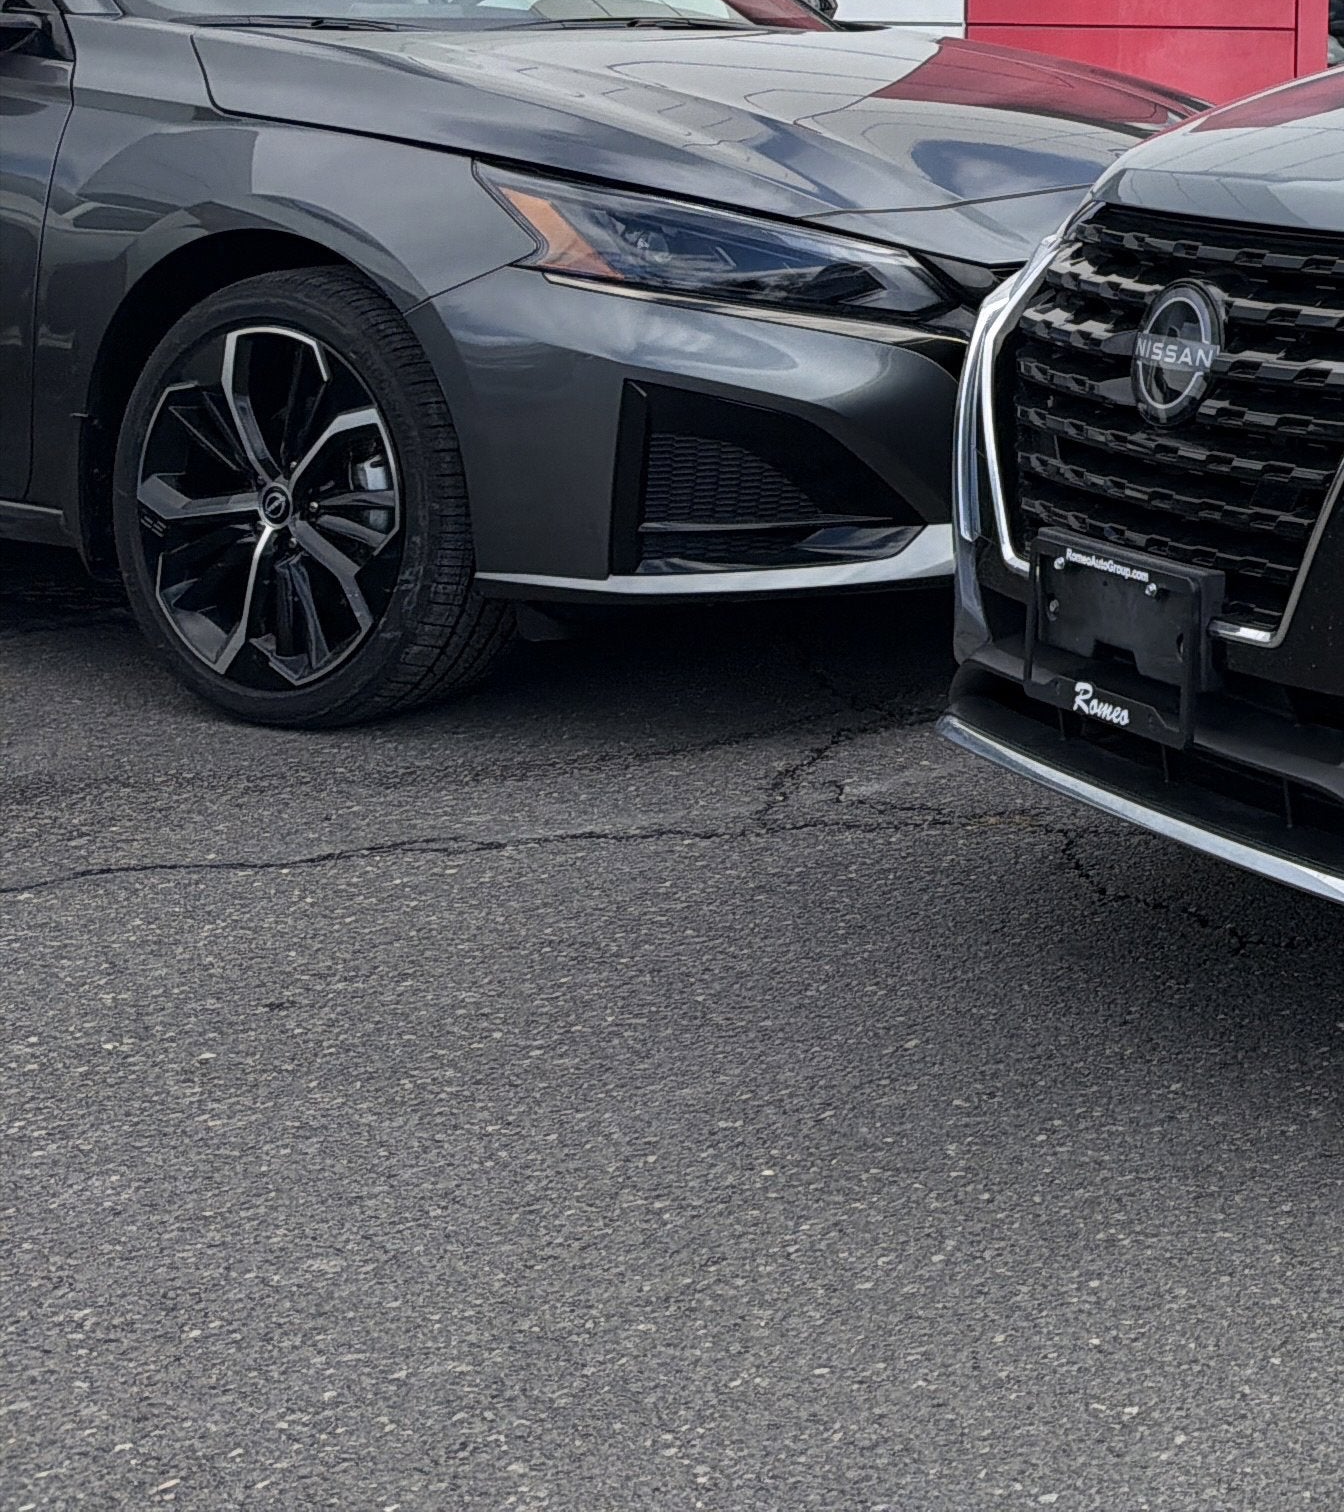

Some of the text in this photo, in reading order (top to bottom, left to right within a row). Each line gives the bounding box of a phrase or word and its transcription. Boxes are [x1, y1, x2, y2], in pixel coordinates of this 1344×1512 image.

[1135, 337, 1214, 368] NISSAN
[1065, 548, 1149, 583] RomeoAutoGroup.com
[1073, 681, 1129, 726] Romeo
